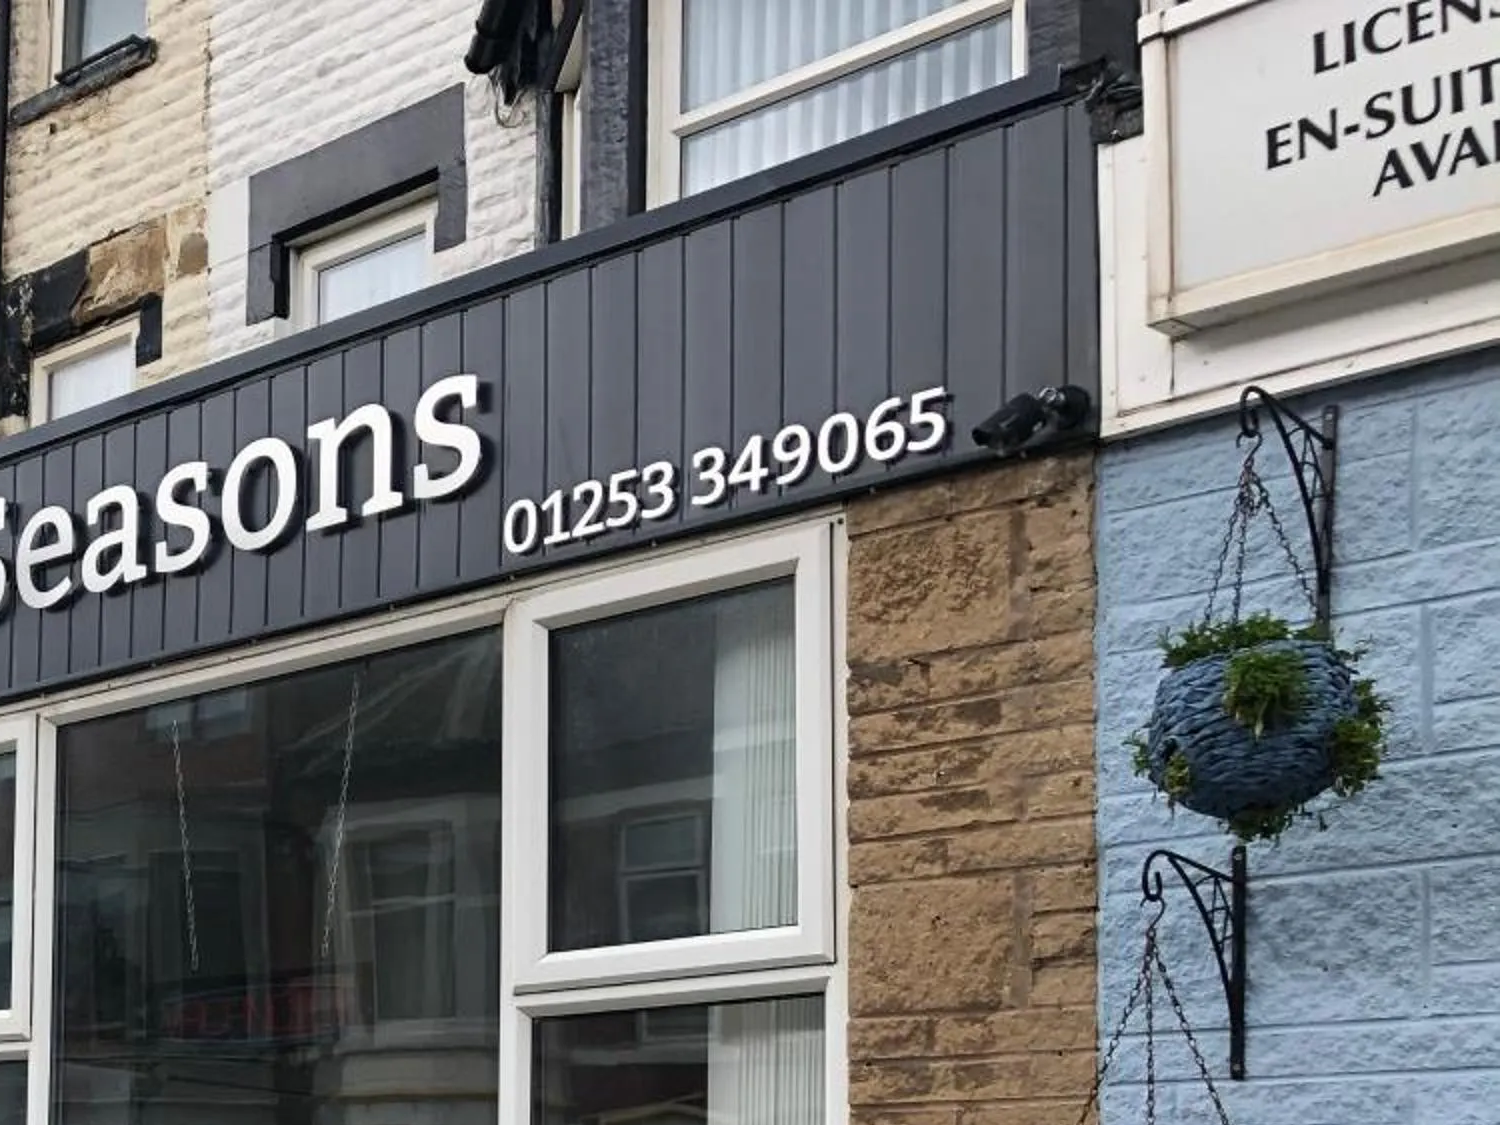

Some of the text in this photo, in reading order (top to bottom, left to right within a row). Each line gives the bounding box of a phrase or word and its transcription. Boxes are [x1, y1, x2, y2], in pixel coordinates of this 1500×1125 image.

[1313, 0, 1500, 75] LICEN
[1266, 57, 1500, 170] EN-SUIT
[503, 386, 947, 554] 01253 349065
